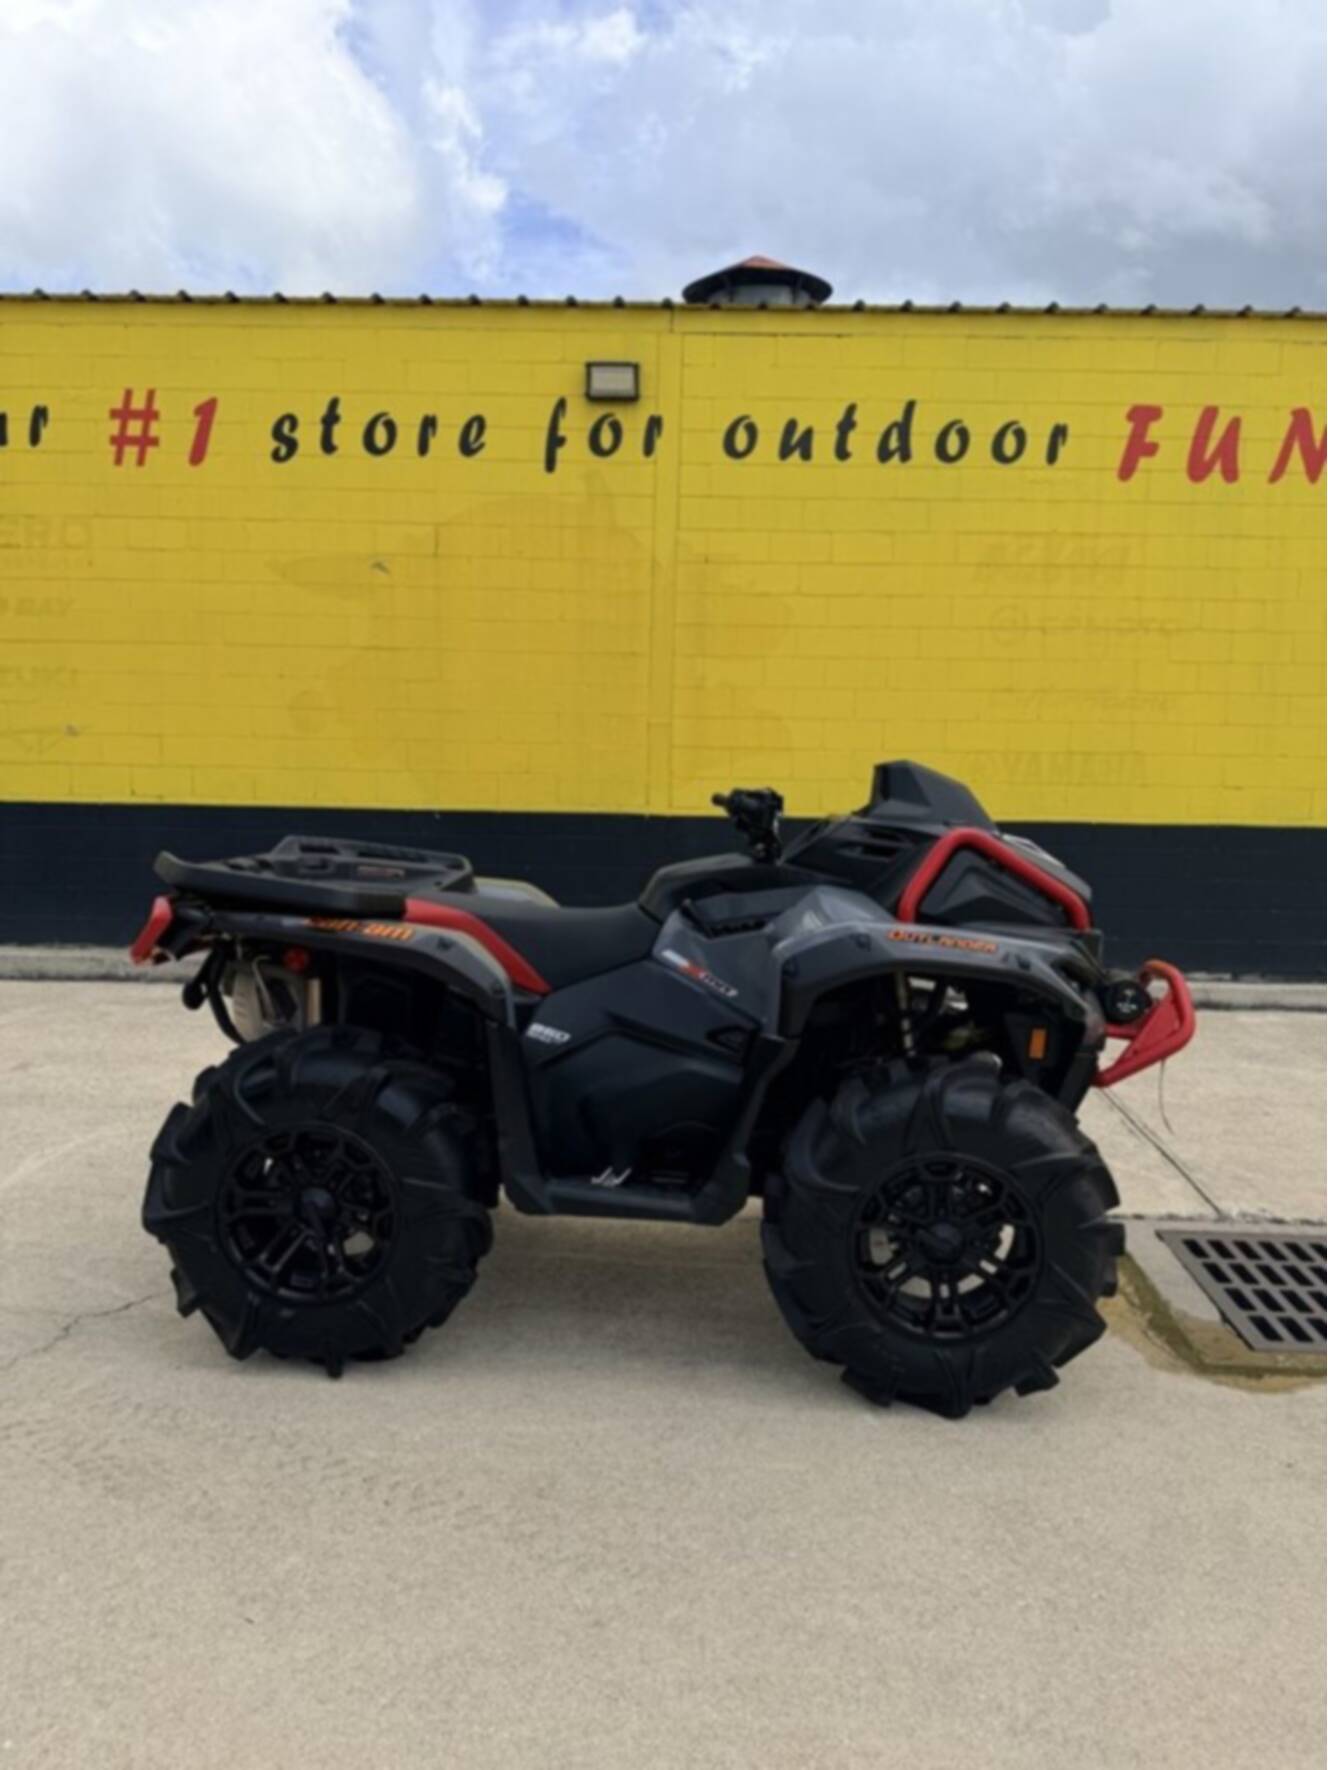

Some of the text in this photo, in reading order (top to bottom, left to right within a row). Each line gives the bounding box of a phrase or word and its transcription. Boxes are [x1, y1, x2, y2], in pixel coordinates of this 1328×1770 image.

[109, 388, 218, 467] #1
[271, 397, 486, 463] store
[544, 397, 663, 473] for
[723, 400, 1068, 465] outdoor
[1116, 405, 1328, 481] FUN
